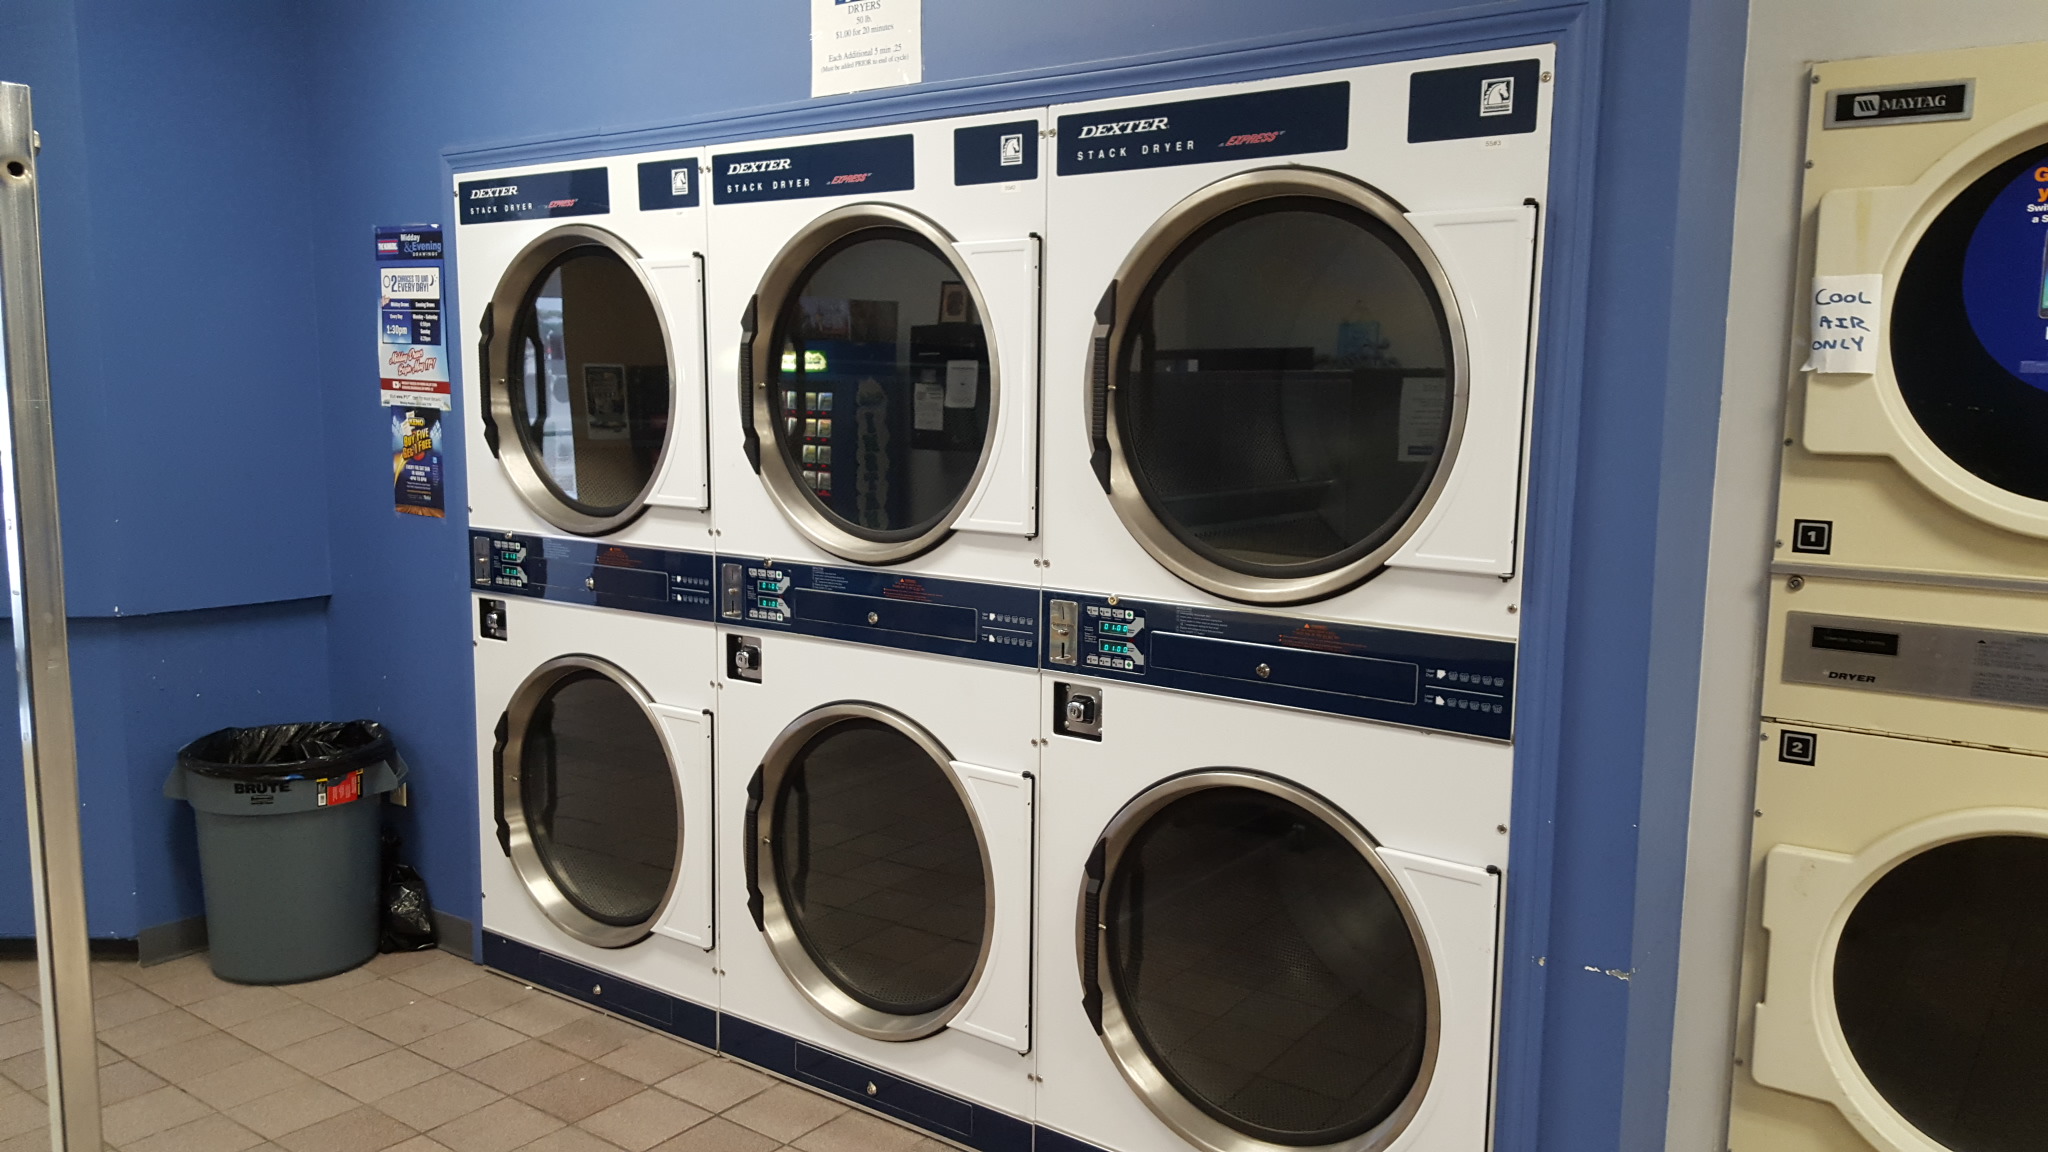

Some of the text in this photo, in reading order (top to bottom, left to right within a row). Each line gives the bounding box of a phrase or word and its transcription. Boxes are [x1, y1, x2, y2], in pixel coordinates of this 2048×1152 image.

[847, 1, 881, 15] DRYERS
[856, 16, 864, 24] 50
[835, 24, 894, 39] $1.00 for 20 minutes
[828, 54, 842, 62] Each
[843, 48, 873, 60] Additional
[1882, 95, 1947, 110] MAYTAG
[1078, 117, 1169, 139] DEXTER
[1226, 131, 1278, 146] EXPRESS
[1077, 140, 1195, 160] STACK DRYER
[727, 158, 792, 175] DEXTER
[727, 178, 811, 193] STACK DRYER
[831, 173, 868, 185] EXPRESS
[470, 185, 518, 199] DEXTER
[470, 202, 533, 215] STACK DRYER
[548, 199, 576, 209] EXPRESS
[400, 233, 420, 242] Midday
[391, 275, 398, 292] 2
[398, 283, 415, 292] EVERY
[1815, 288, 1872, 305] COOL
[386, 325, 408, 336] 1:30pm
[1819, 316, 1871, 332] AIR
[1812, 336, 1865, 352] ONLY
[403, 428, 429, 447] BUY FIVE
[418, 438, 432, 452] FREE
[1807, 531, 1817, 543] 1
[1828, 671, 1876, 683] DRYER
[1792, 741, 1803, 753] 2
[234, 782, 292, 794] BRUTE
